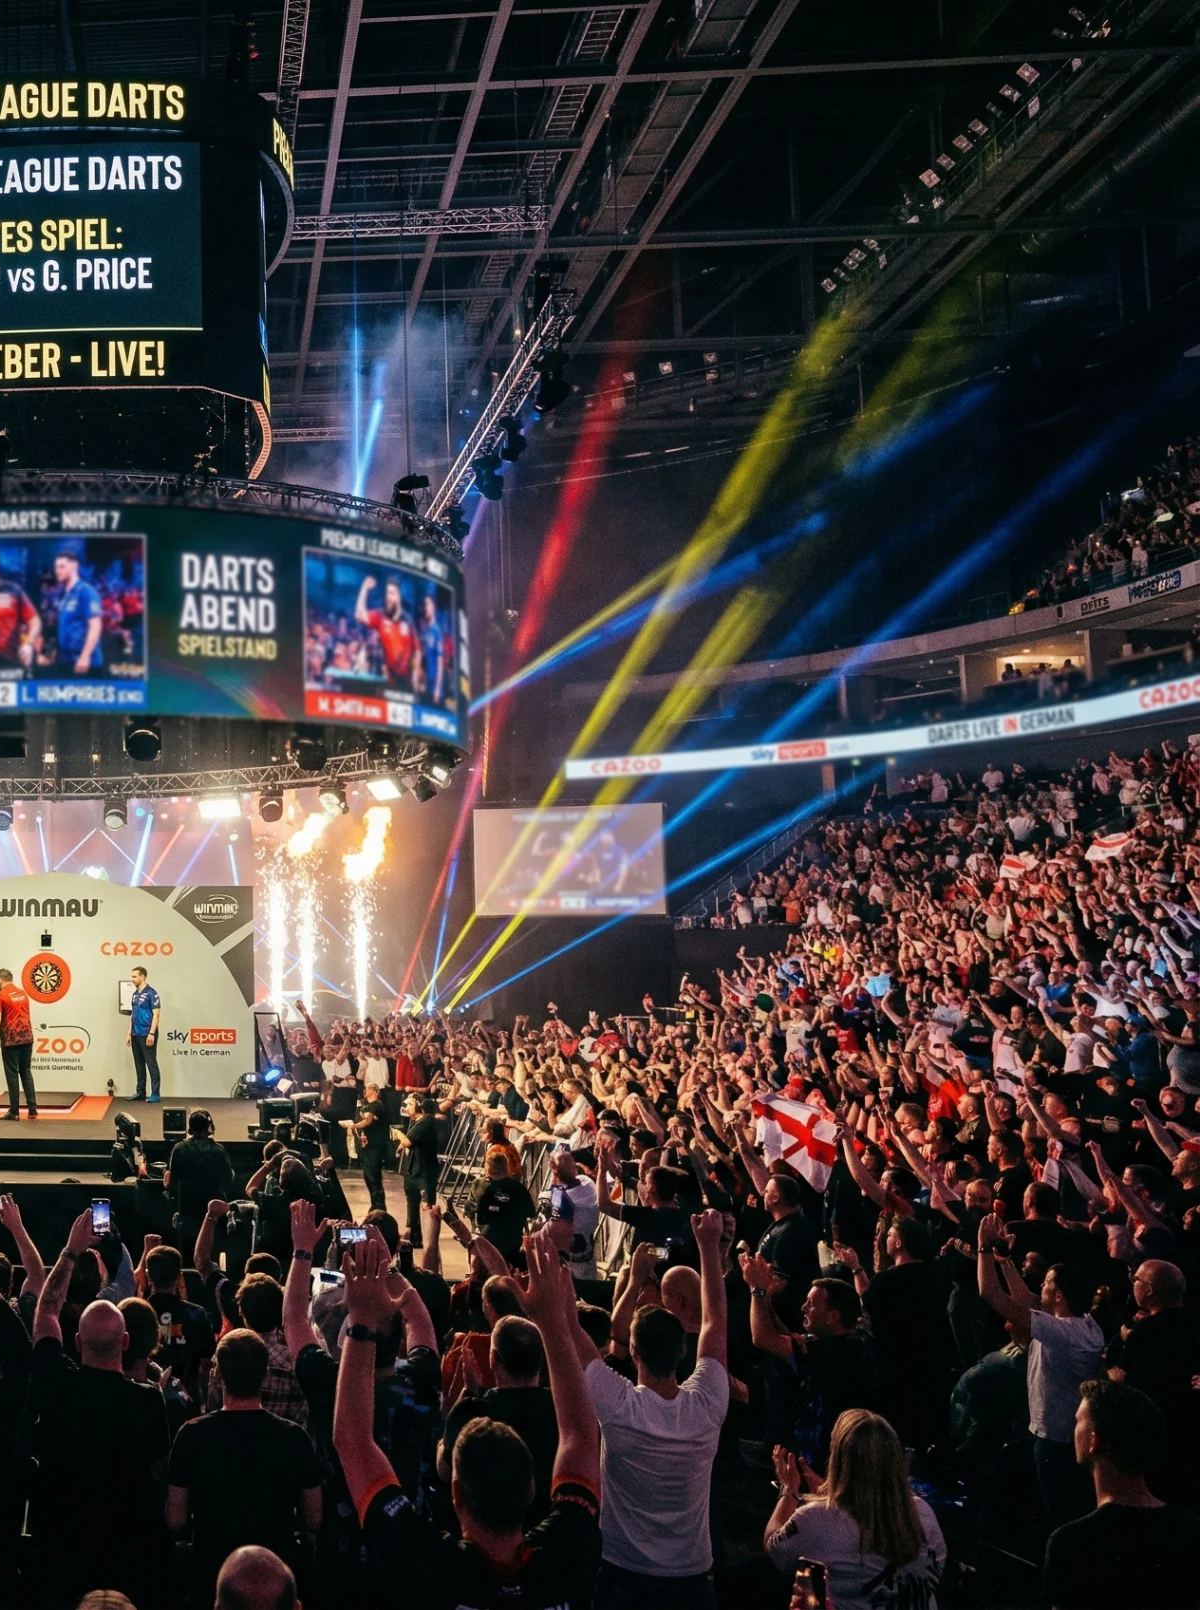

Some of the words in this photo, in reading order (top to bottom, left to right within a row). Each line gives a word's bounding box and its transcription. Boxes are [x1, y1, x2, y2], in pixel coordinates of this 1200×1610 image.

[88, 83, 184, 120] DARTS
[89, 156, 182, 190] DARTS
[41, 219, 122, 251] SPIEL:
[43, 259, 68, 292] G.
[77, 257, 152, 290] PRICE
[92, 341, 164, 376] LIVE!
[0, 511, 48, 531] DARTS
[61, 511, 106, 530] NIGHT
[110, 511, 121, 530] 7
[181, 552, 275, 594] DARTS
[180, 594, 276, 634] ABEND
[178, 634, 277, 661] SPIELSTAND
[0, 686, 11, 703] 2
[928, 724, 970, 744] DARTS
[973, 719, 1000, 739] LIVE
[1003, 716, 1018, 734] IN
[1020, 708, 1075, 732] GERMAN
[590, 758, 661, 775] CAZOO
[100, 941, 174, 956] CAZOO
[36, 1038, 85, 1054] ZOO
[166, 1029, 189, 1044] sky
[193, 1031, 234, 1044] sports
[172, 1048, 188, 1056] Live
[190, 1048, 198, 1056] in
[199, 1048, 231, 1056] German
